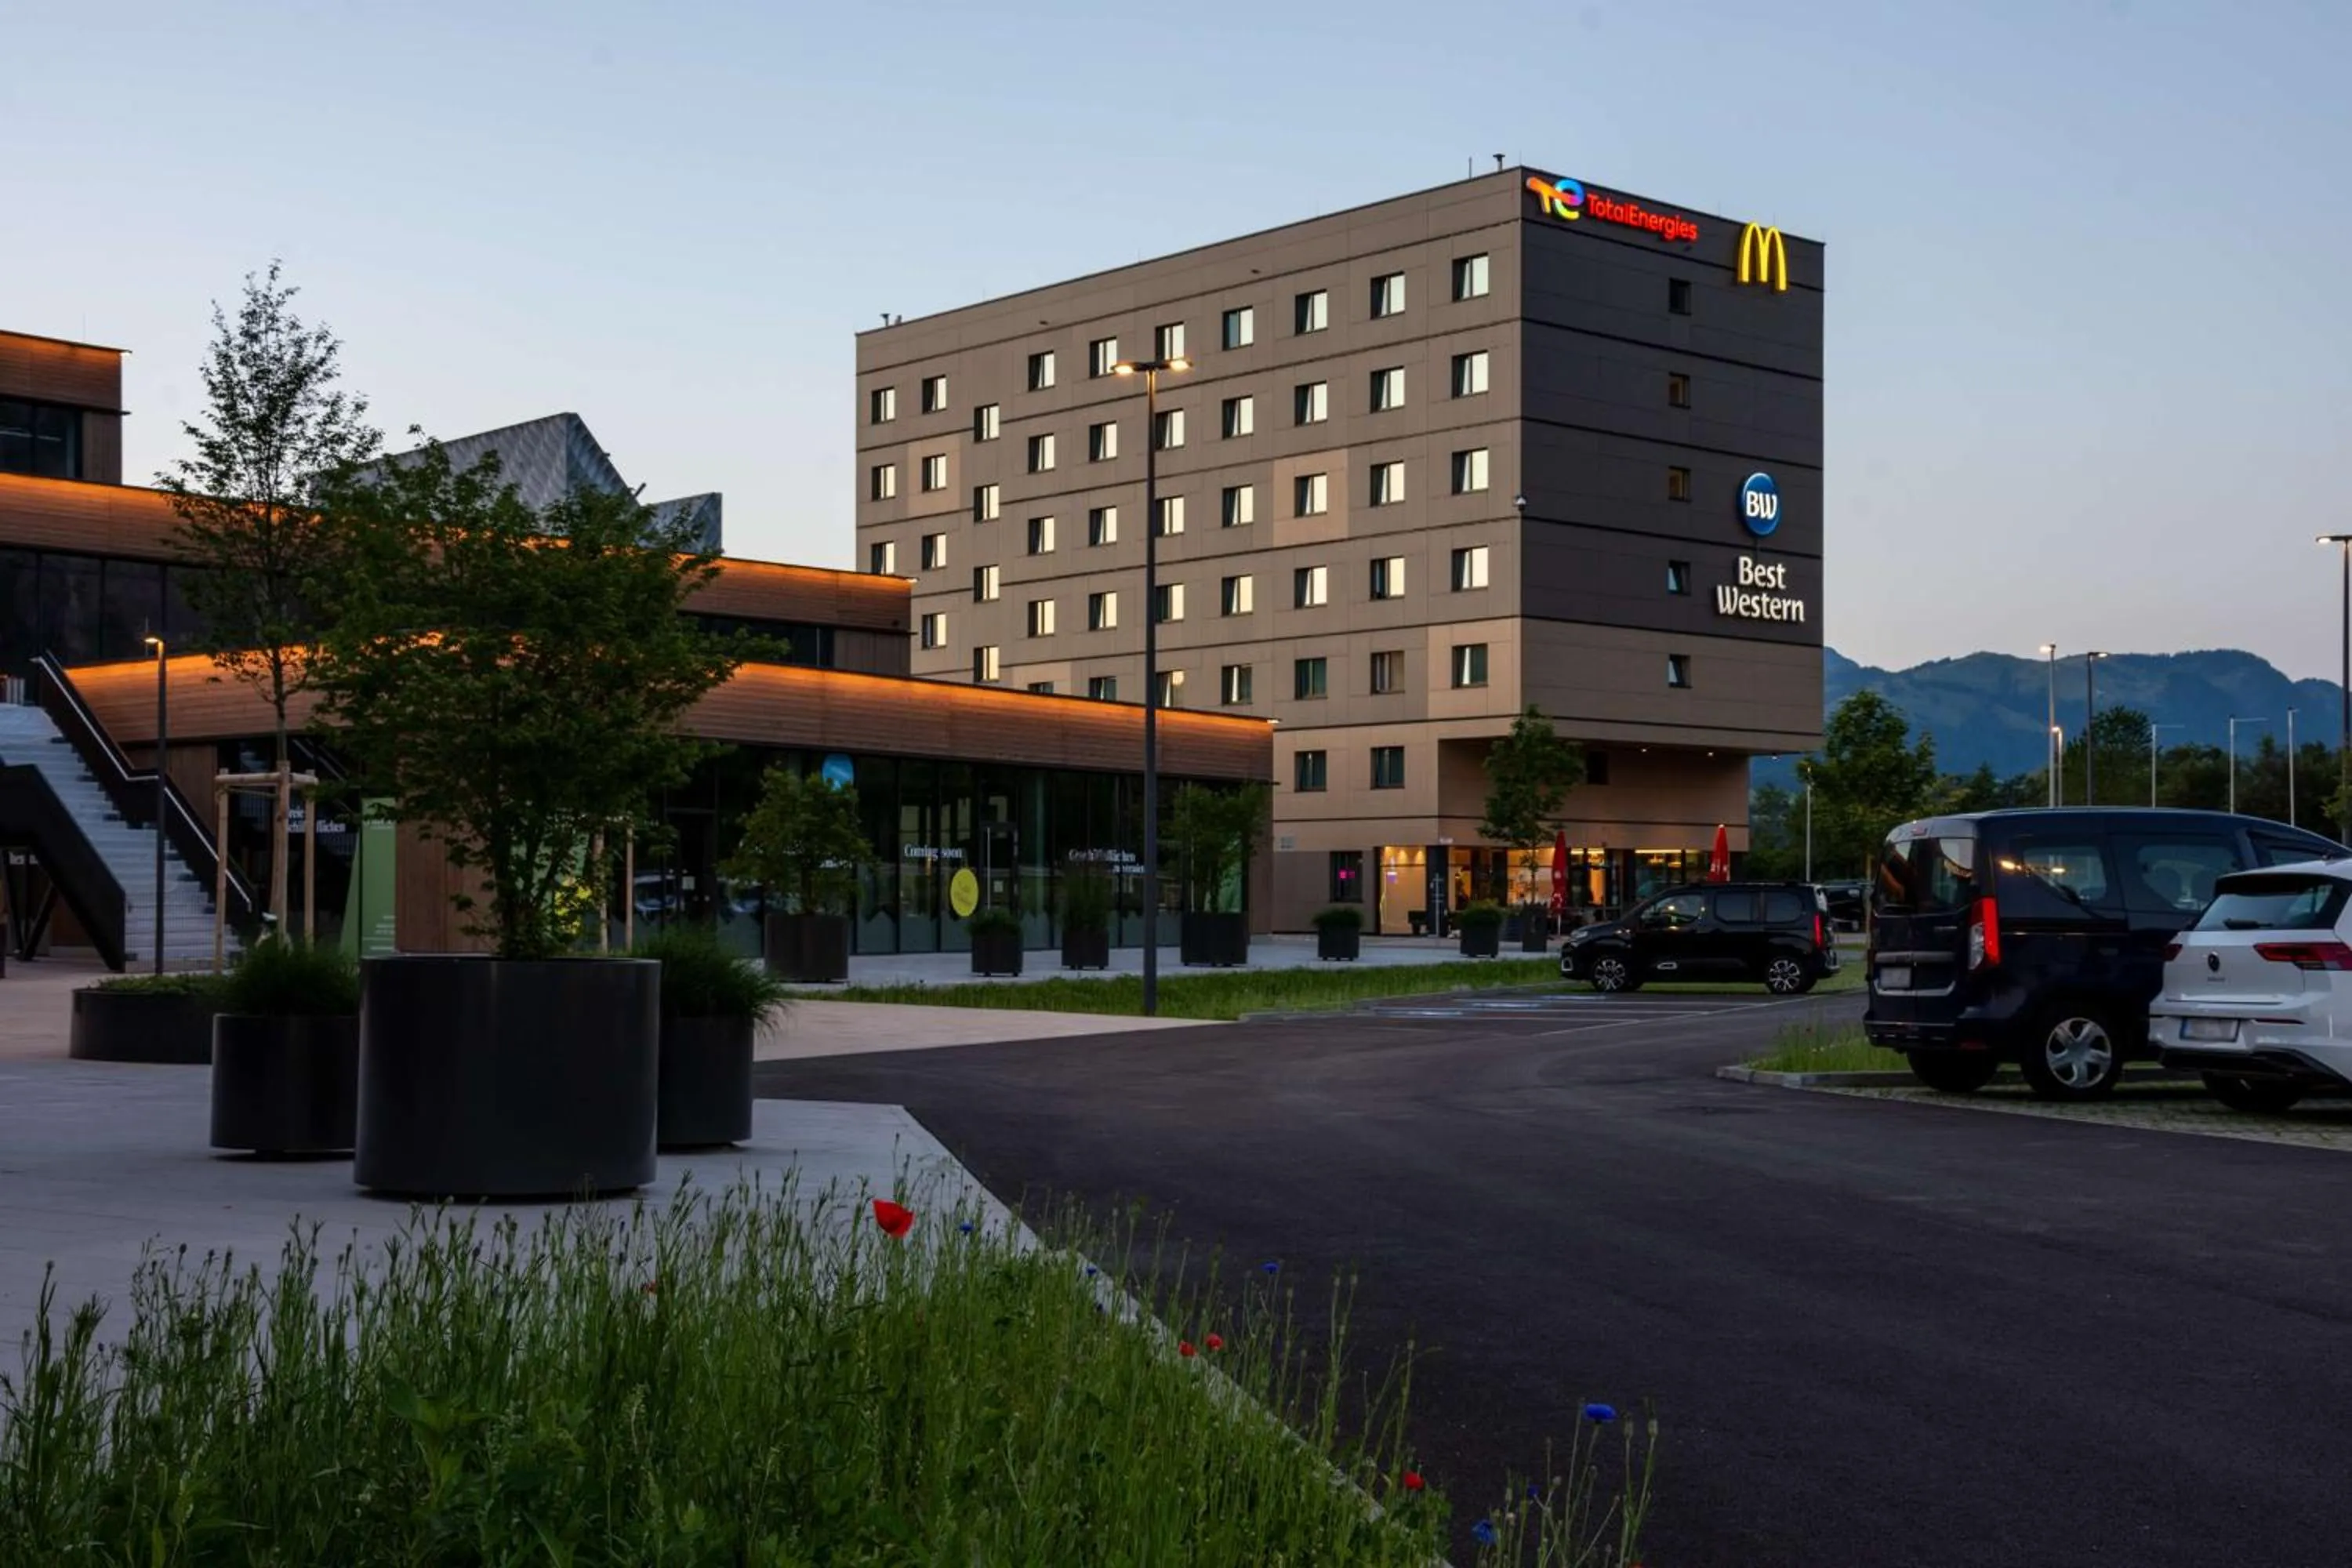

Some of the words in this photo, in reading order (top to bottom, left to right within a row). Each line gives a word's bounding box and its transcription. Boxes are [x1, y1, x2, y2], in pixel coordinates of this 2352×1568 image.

[1586, 193, 1698, 241] TotalEnergies
[1745, 490, 1777, 521] BW
[1738, 556, 1786, 590] Best
[1715, 585, 1805, 622] Western
[904, 843, 938, 861] Coming
[941, 847, 962, 858] soon
